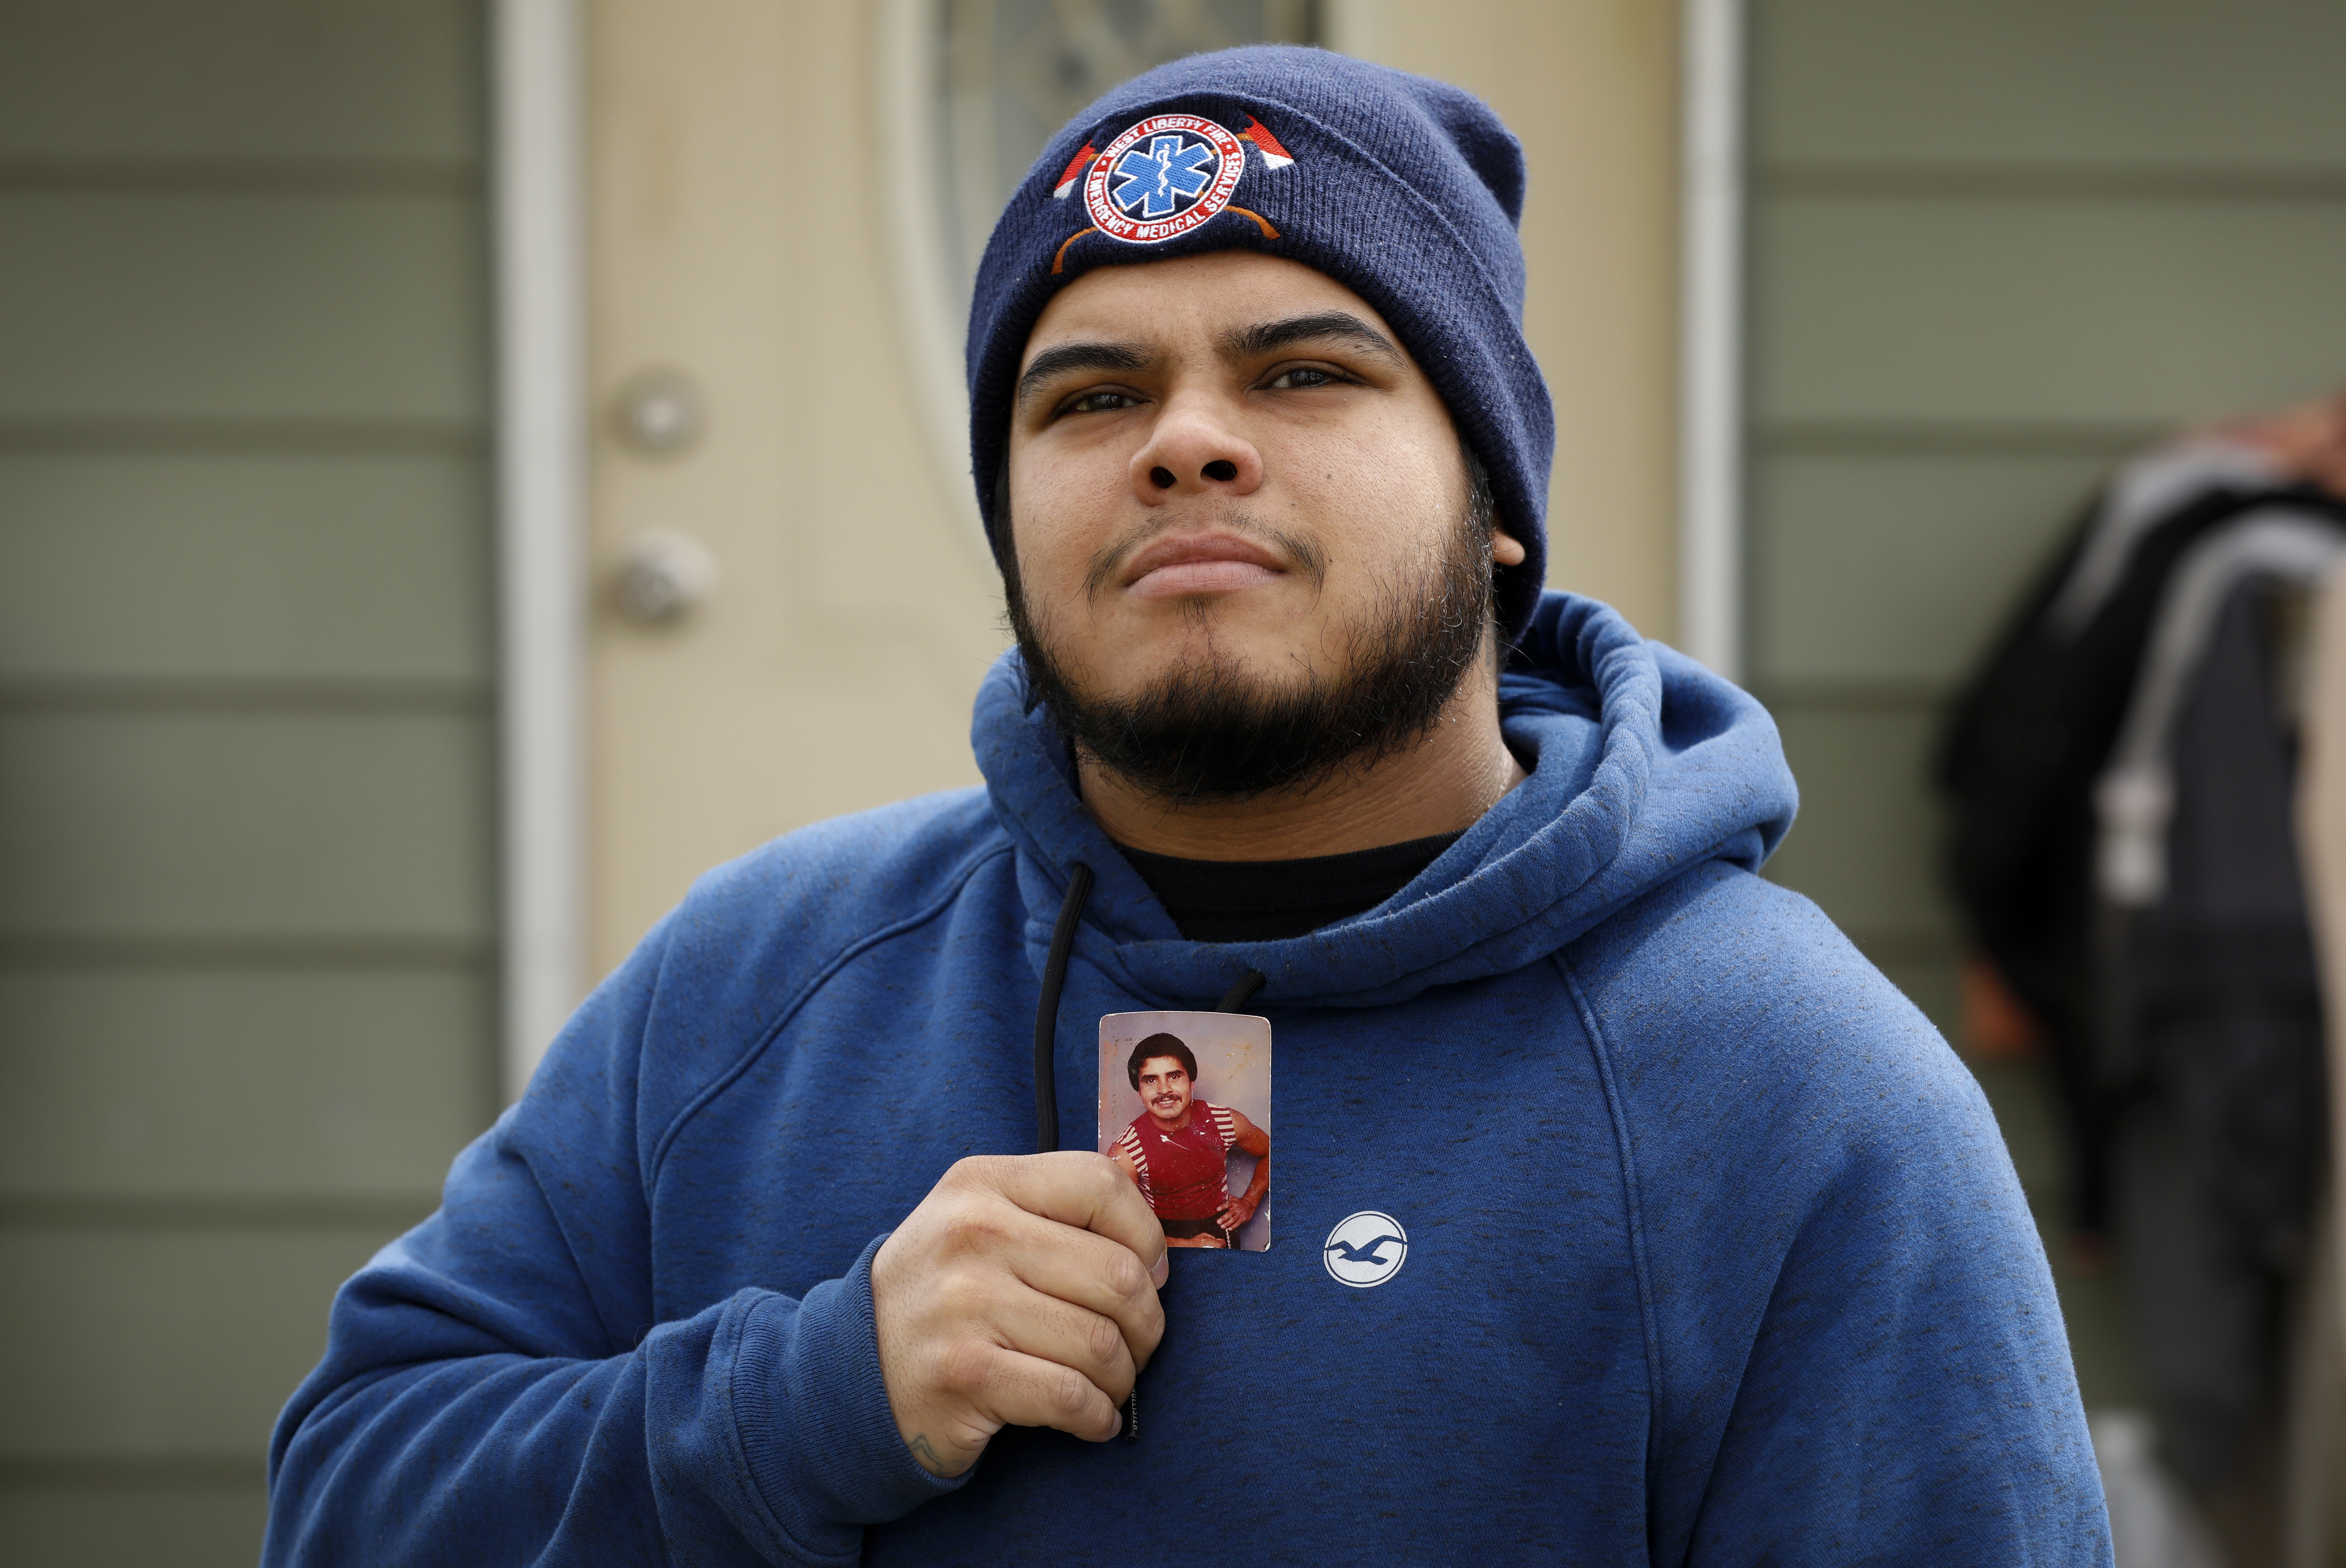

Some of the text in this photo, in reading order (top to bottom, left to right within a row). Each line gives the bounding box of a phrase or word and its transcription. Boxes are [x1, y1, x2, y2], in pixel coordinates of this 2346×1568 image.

[1107, 118, 1230, 157] WEST LIBERTY FIRE
[1089, 152, 1241, 238] EMERGENCY MEDICAL SERVICES
